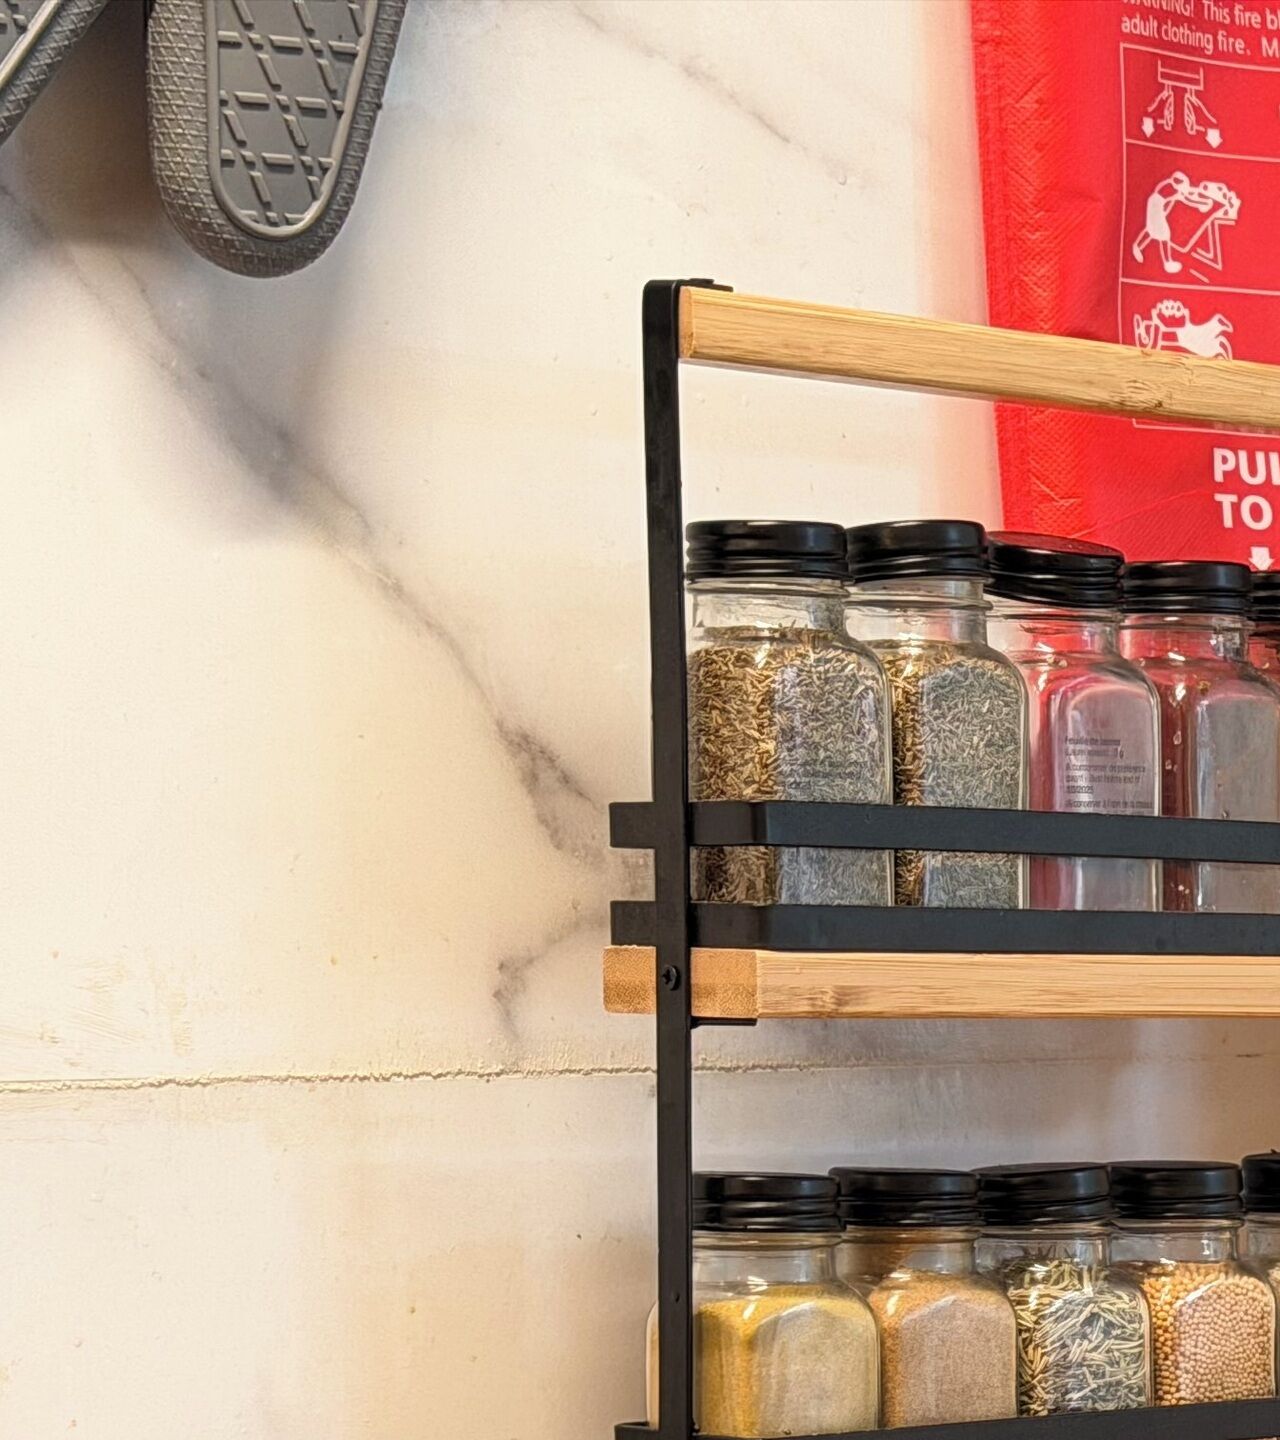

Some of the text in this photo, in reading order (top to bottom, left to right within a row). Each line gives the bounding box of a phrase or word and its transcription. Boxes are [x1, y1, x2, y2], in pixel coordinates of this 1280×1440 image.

[1203, 1, 1230, 25] This
[1234, 5, 1262, 29] fire
[1121, 13, 1158, 38] adult
[1161, 22, 1214, 55] clothing
[1217, 30, 1251, 56] fire.
[1214, 493, 1274, 531] TO
